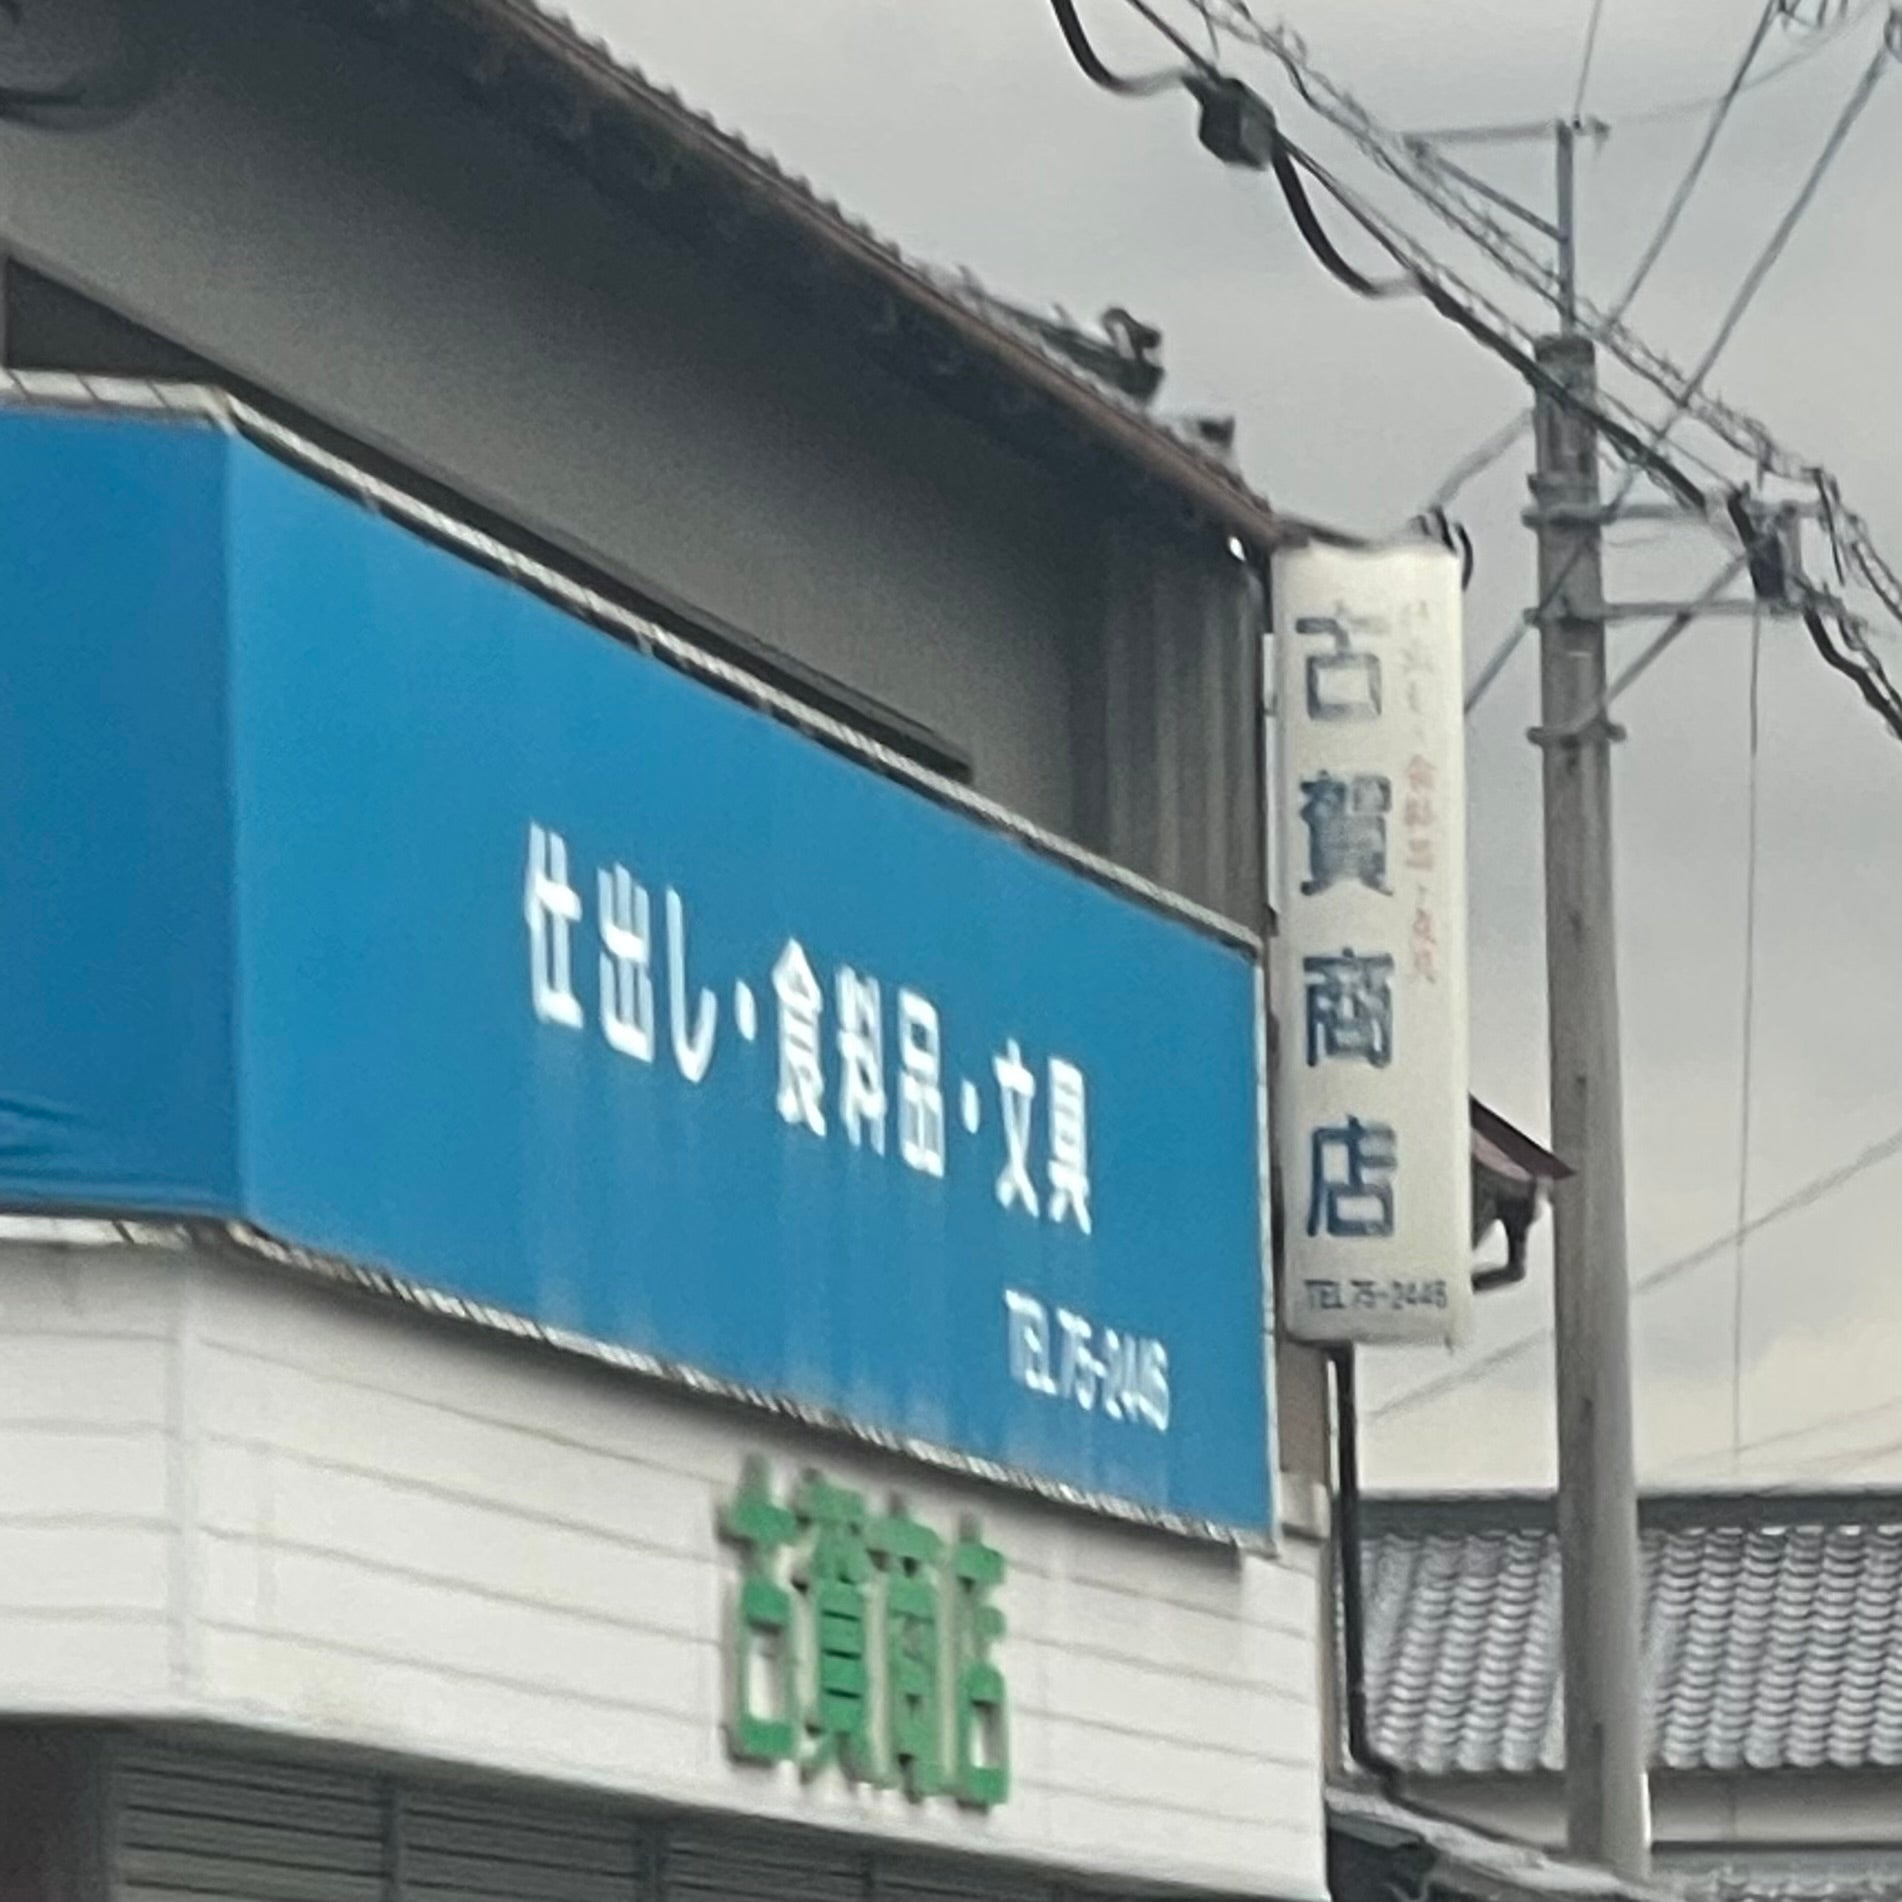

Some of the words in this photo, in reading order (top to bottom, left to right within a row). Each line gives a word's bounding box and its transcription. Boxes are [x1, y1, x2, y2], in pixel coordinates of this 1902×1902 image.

[524, 820, 1092, 1236] 仕出し・食料品・文具
[1296, 602, 1399, 1237] 古賀商店
[1304, 1279, 1345, 1310] TEL
[722, 1453, 1010, 1807] 古賀商店
